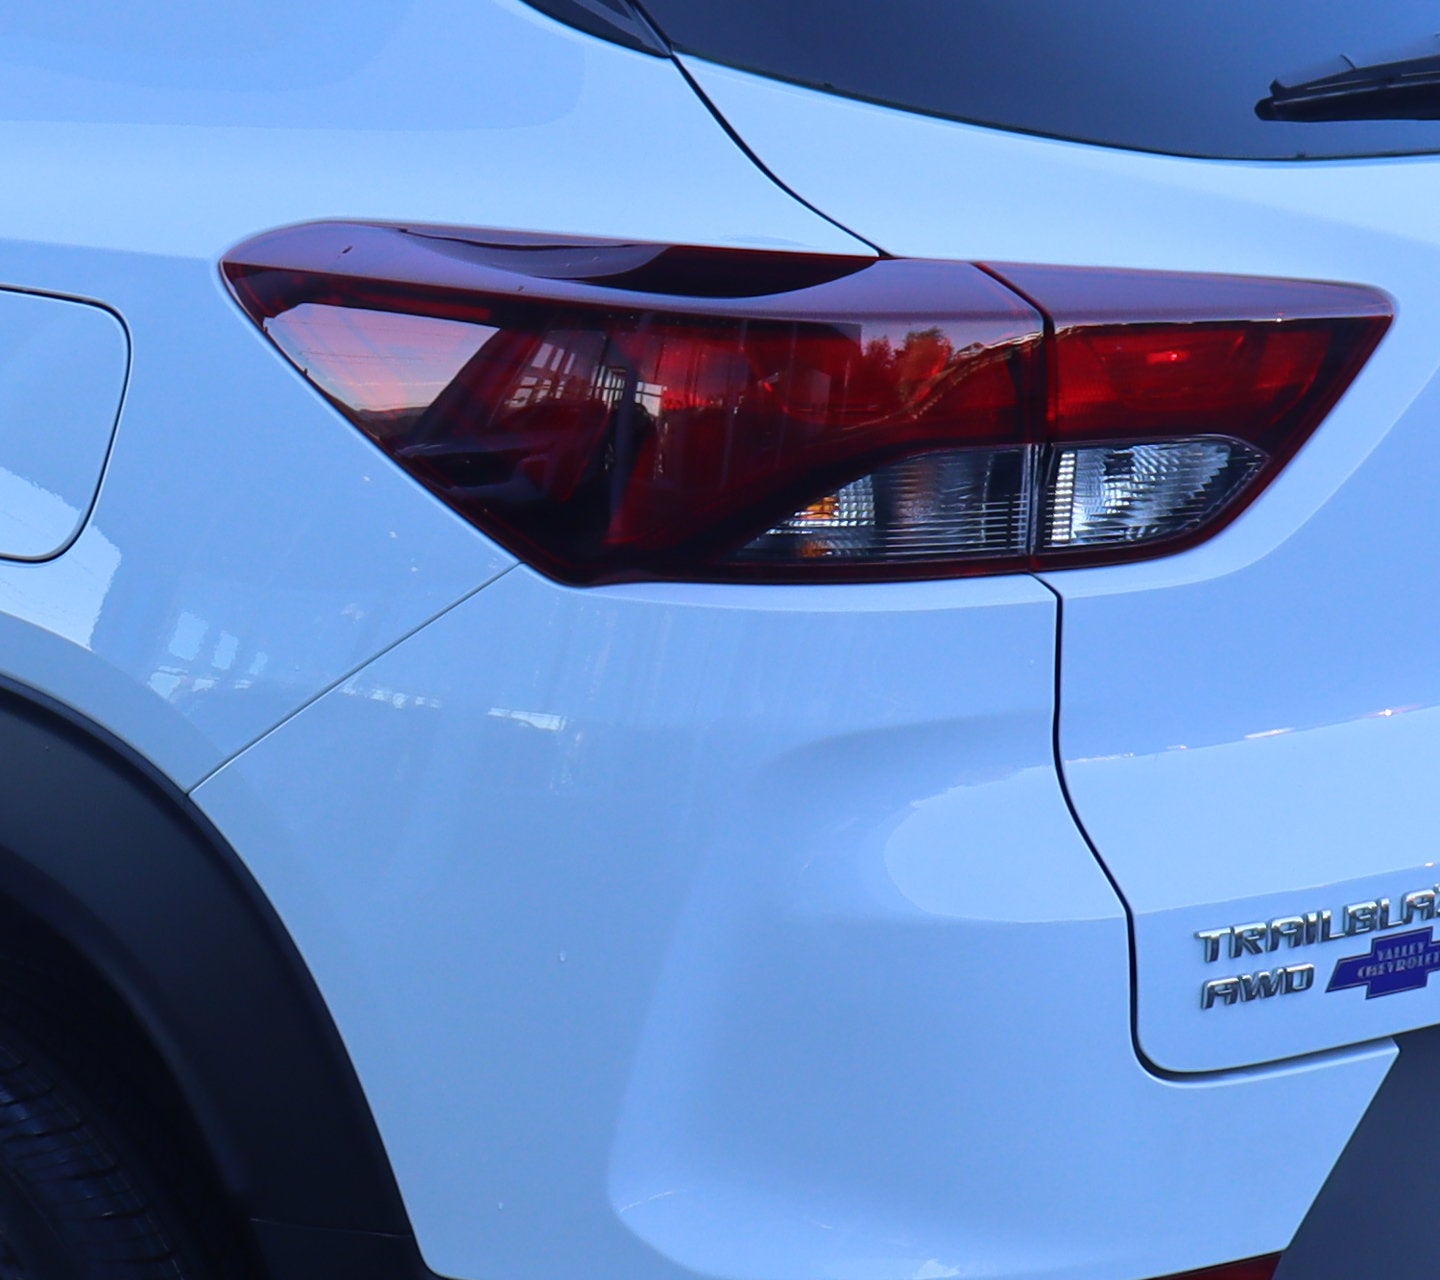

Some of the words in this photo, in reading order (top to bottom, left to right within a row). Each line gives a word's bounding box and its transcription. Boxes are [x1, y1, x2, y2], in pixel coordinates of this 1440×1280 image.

[1357, 951, 1440, 979] CHEVROLET
[1376, 941, 1427, 962] VALLEY
[1201, 963, 1315, 1010] AWD
